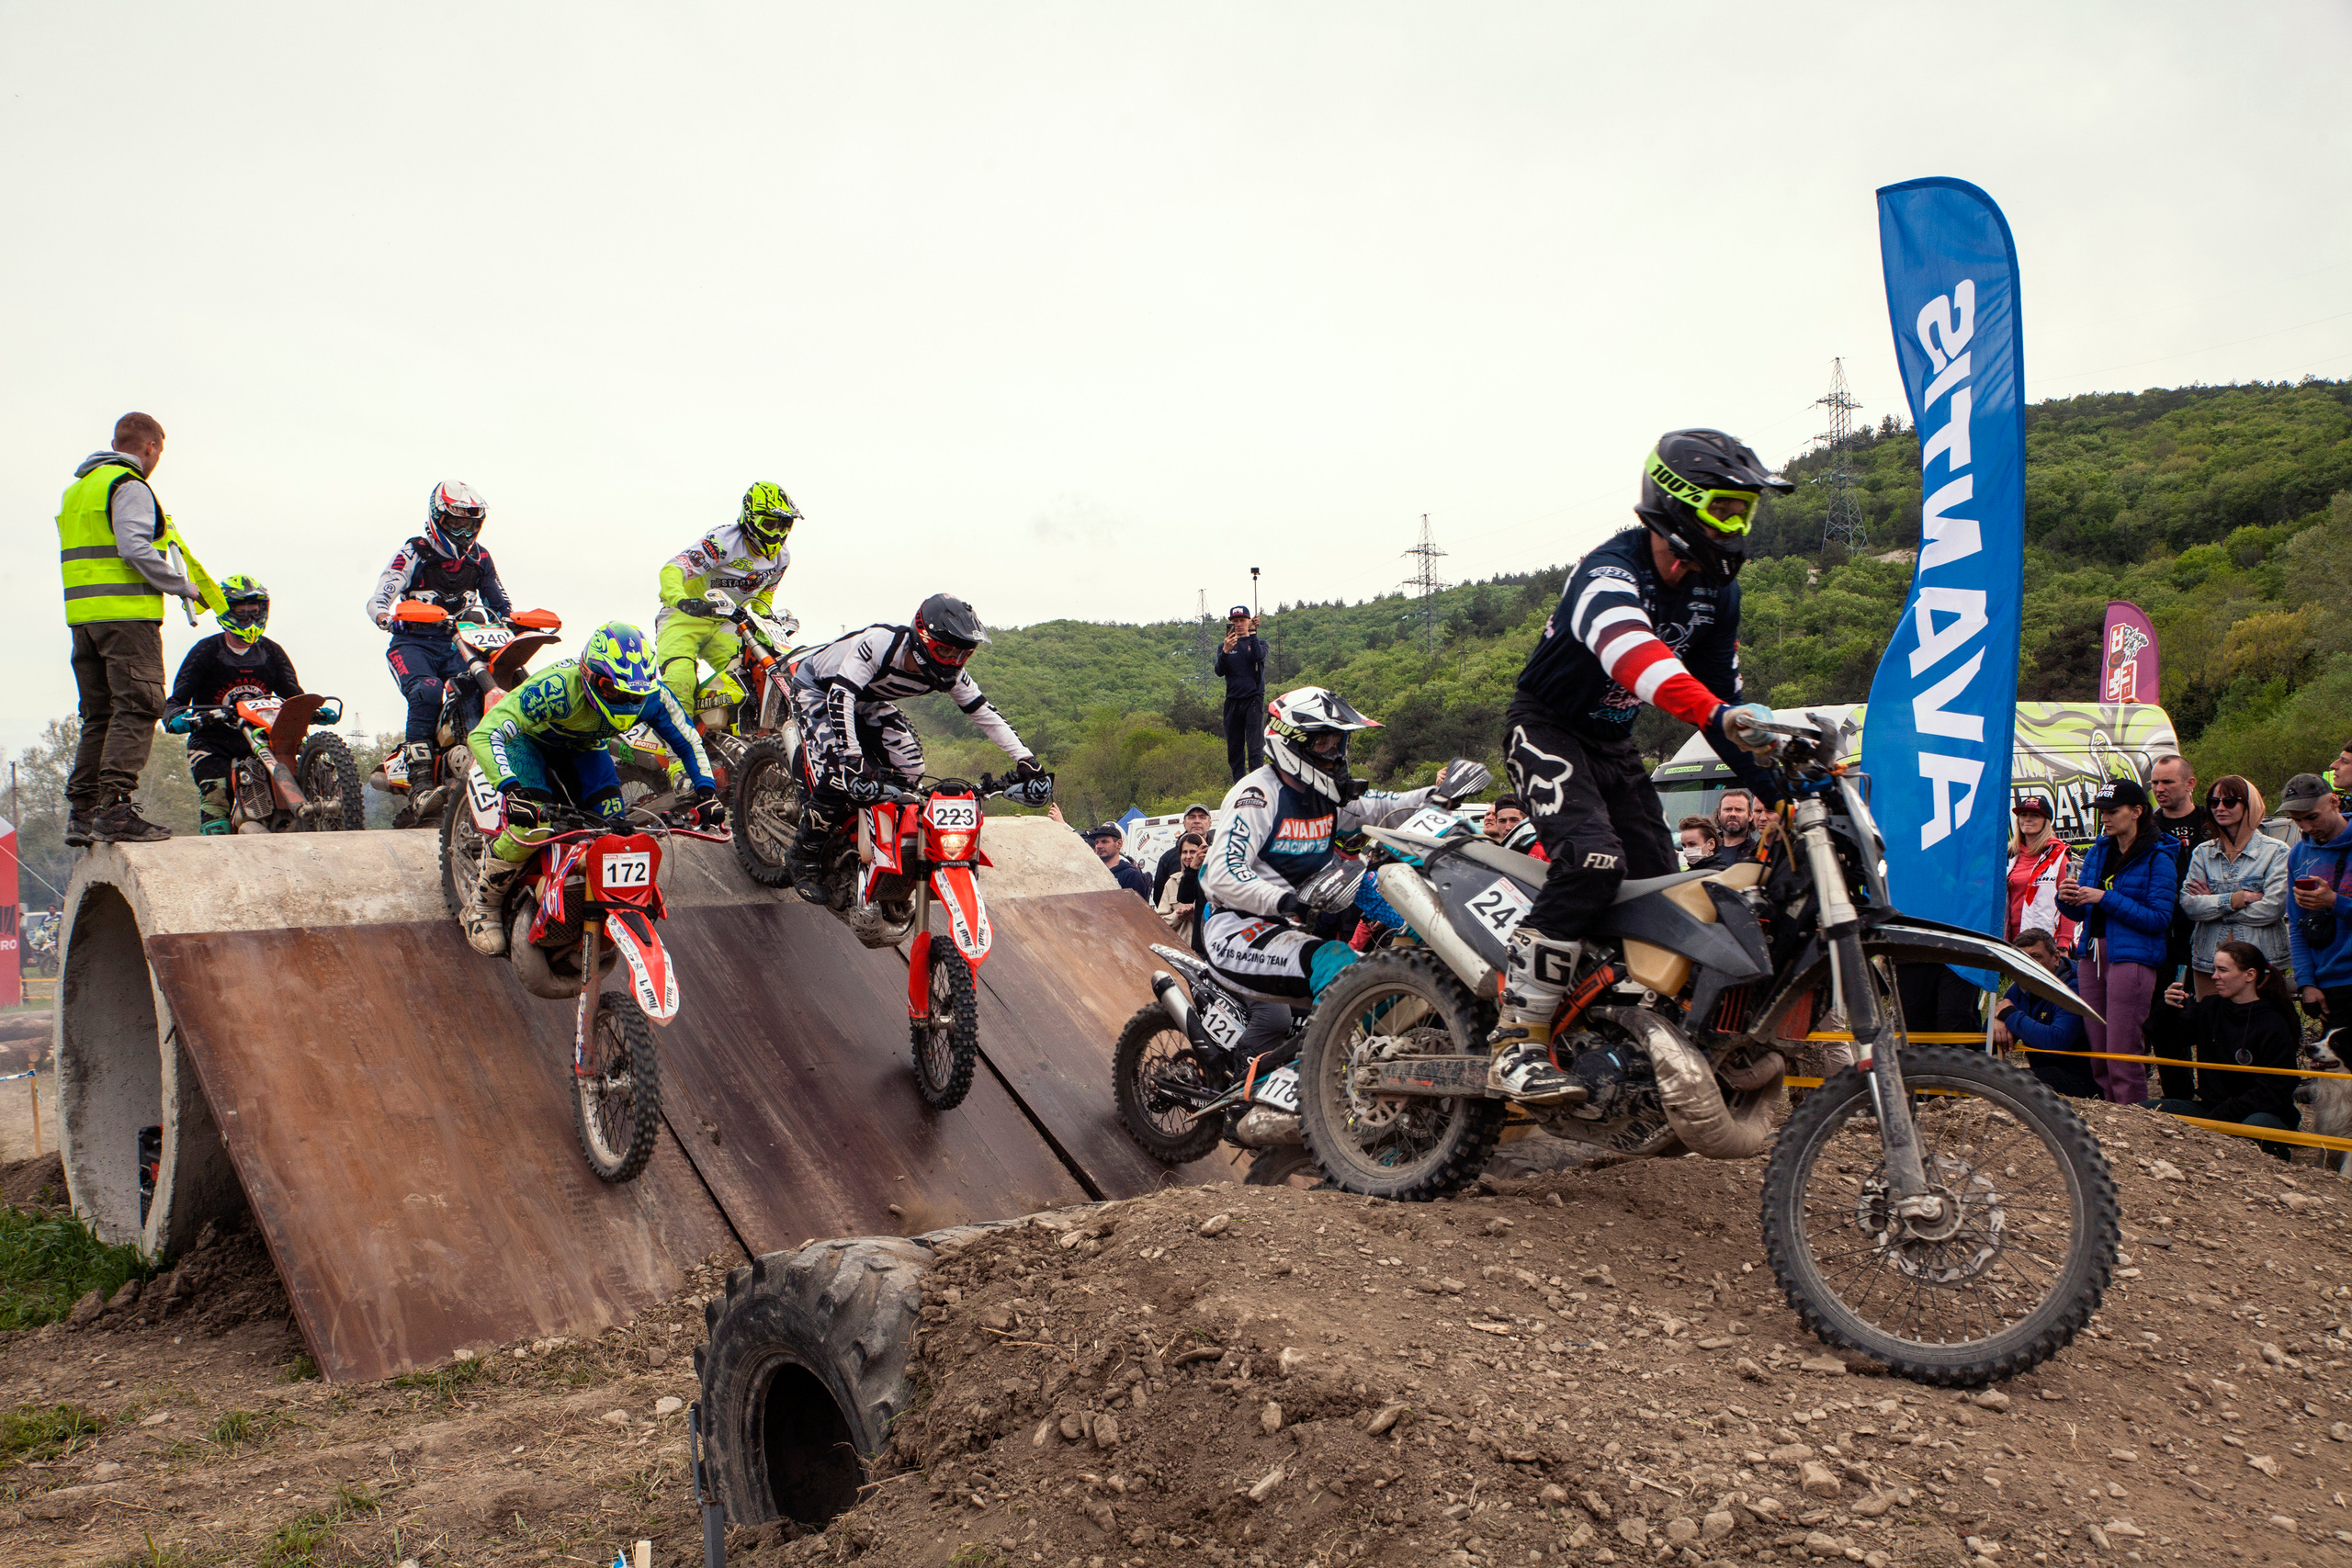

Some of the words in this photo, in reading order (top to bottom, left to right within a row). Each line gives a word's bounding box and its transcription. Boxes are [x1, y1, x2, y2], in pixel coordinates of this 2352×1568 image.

[1651, 464, 1703, 502] 100%
[474, 633, 508, 645] 240
[1268, 716, 1308, 743] 100%
[635, 740, 658, 750] MOTUL
[602, 797, 623, 817] 25
[935, 808, 974, 826] 223
[1278, 814, 1334, 839] AVANTIS
[1272, 840, 1316, 853] RACING
[1582, 852, 1618, 870] FOX
[606, 862, 646, 883] 172
[1236, 950, 1265, 964] RACING
[1267, 954, 1288, 967] TEAM
[1205, 1013, 1237, 1045] 121
